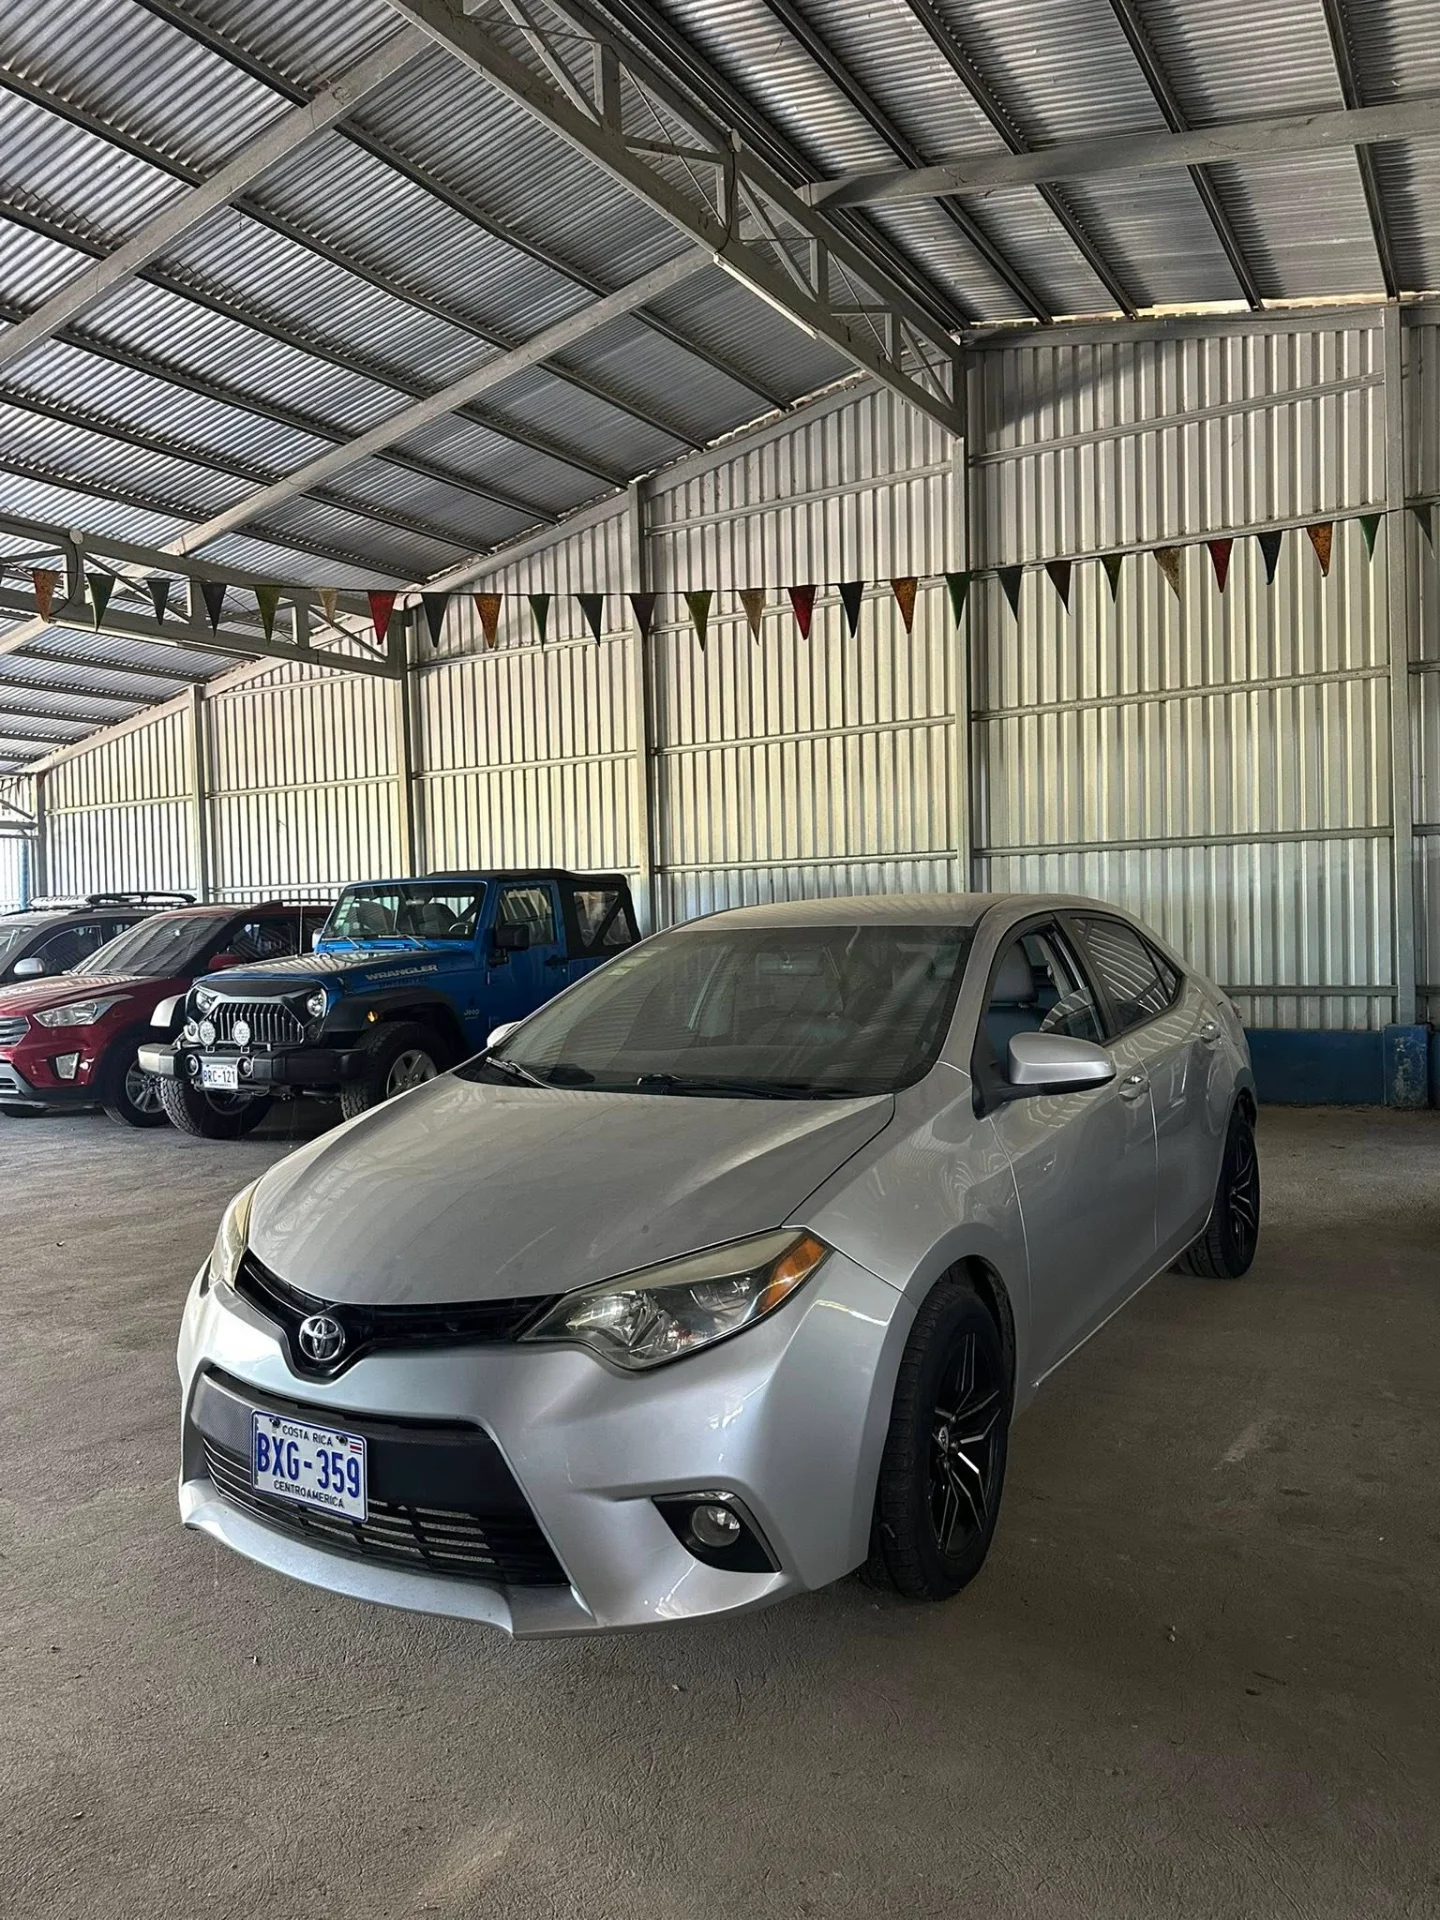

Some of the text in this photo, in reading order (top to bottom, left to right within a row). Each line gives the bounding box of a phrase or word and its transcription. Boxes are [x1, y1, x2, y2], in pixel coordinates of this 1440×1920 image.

[365, 964, 438, 980] WRANGLER
[203, 1070, 236, 1083] BRC-121
[282, 1425, 333, 1447] COSTA RICA
[257, 1432, 360, 1498] BXG-359
[273, 1480, 345, 1509] CENTROAMERICA
